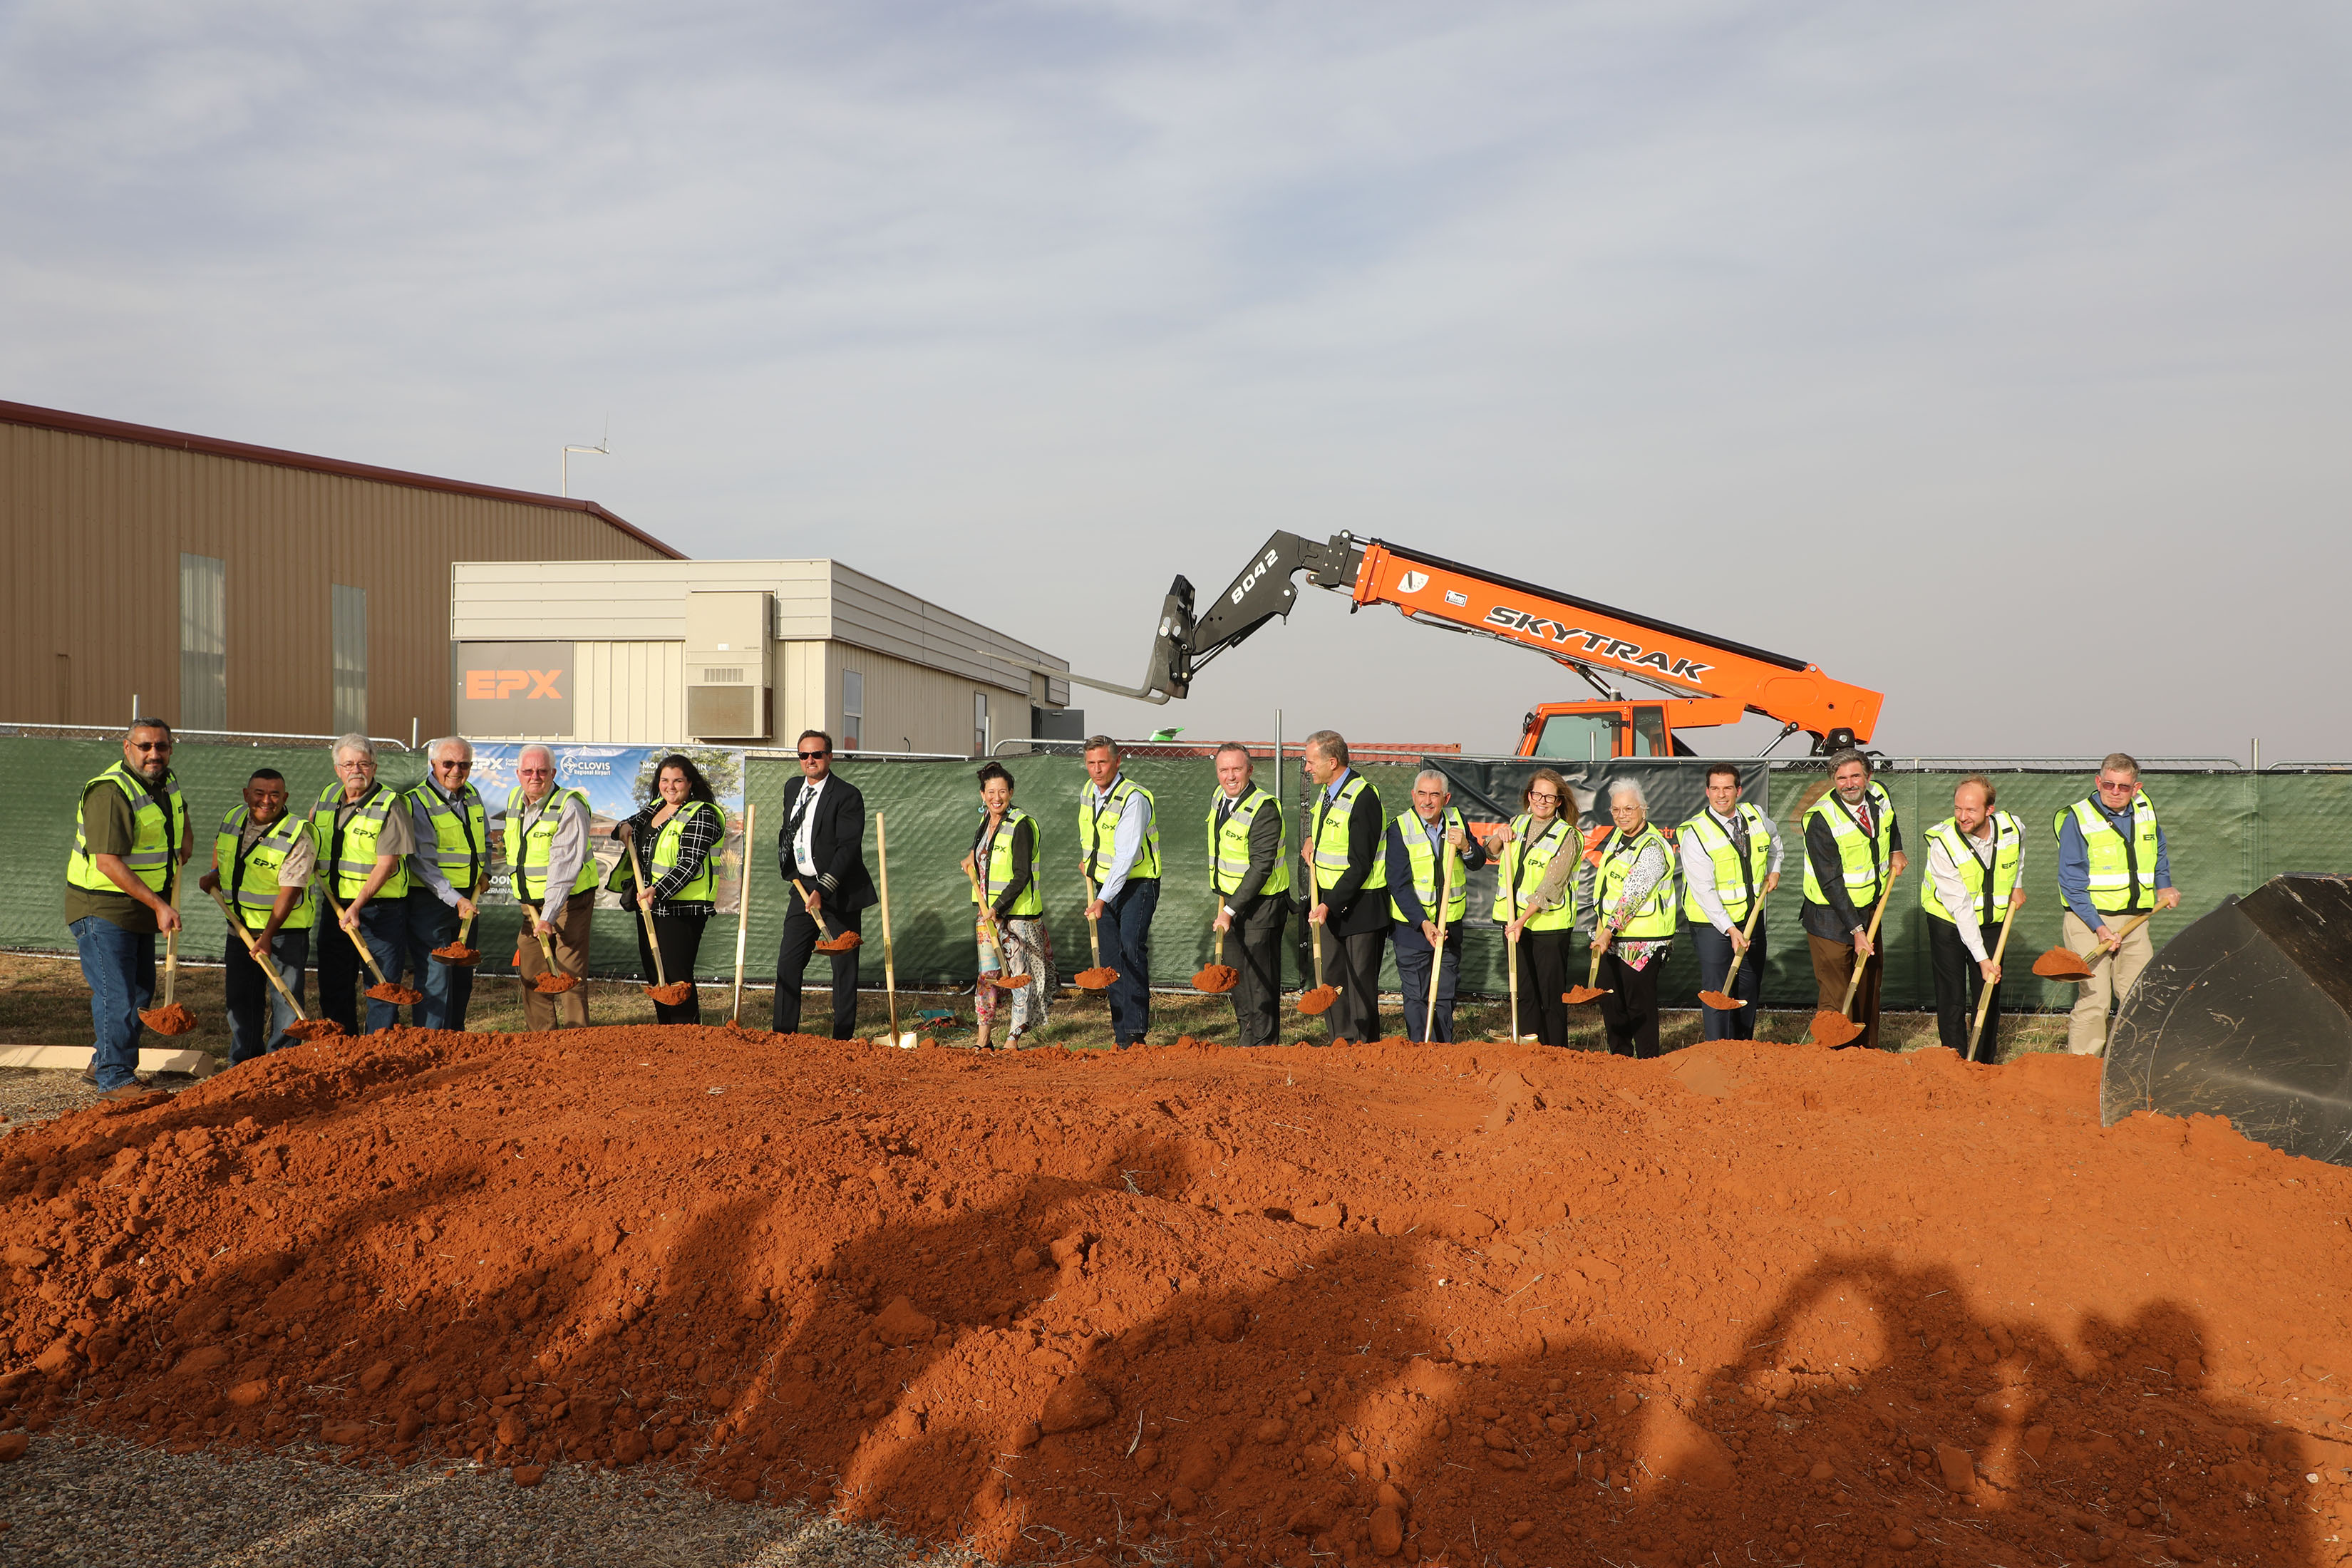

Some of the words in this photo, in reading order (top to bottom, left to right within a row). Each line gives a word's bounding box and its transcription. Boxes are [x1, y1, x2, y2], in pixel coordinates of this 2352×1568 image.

[1231, 548, 1279, 604] 8042
[1484, 606, 1715, 684] SKYTRAK
[465, 669, 563, 700] EPX
[578, 761, 611, 770] CLOVIS
[1101, 822, 1116, 831] EPX
[1325, 817, 1340, 828] EPX
[353, 827, 376, 840] EPX
[1225, 830, 1243, 841] EPX
[252, 857, 278, 870] EPX
[1527, 859, 1545, 868] EPX
